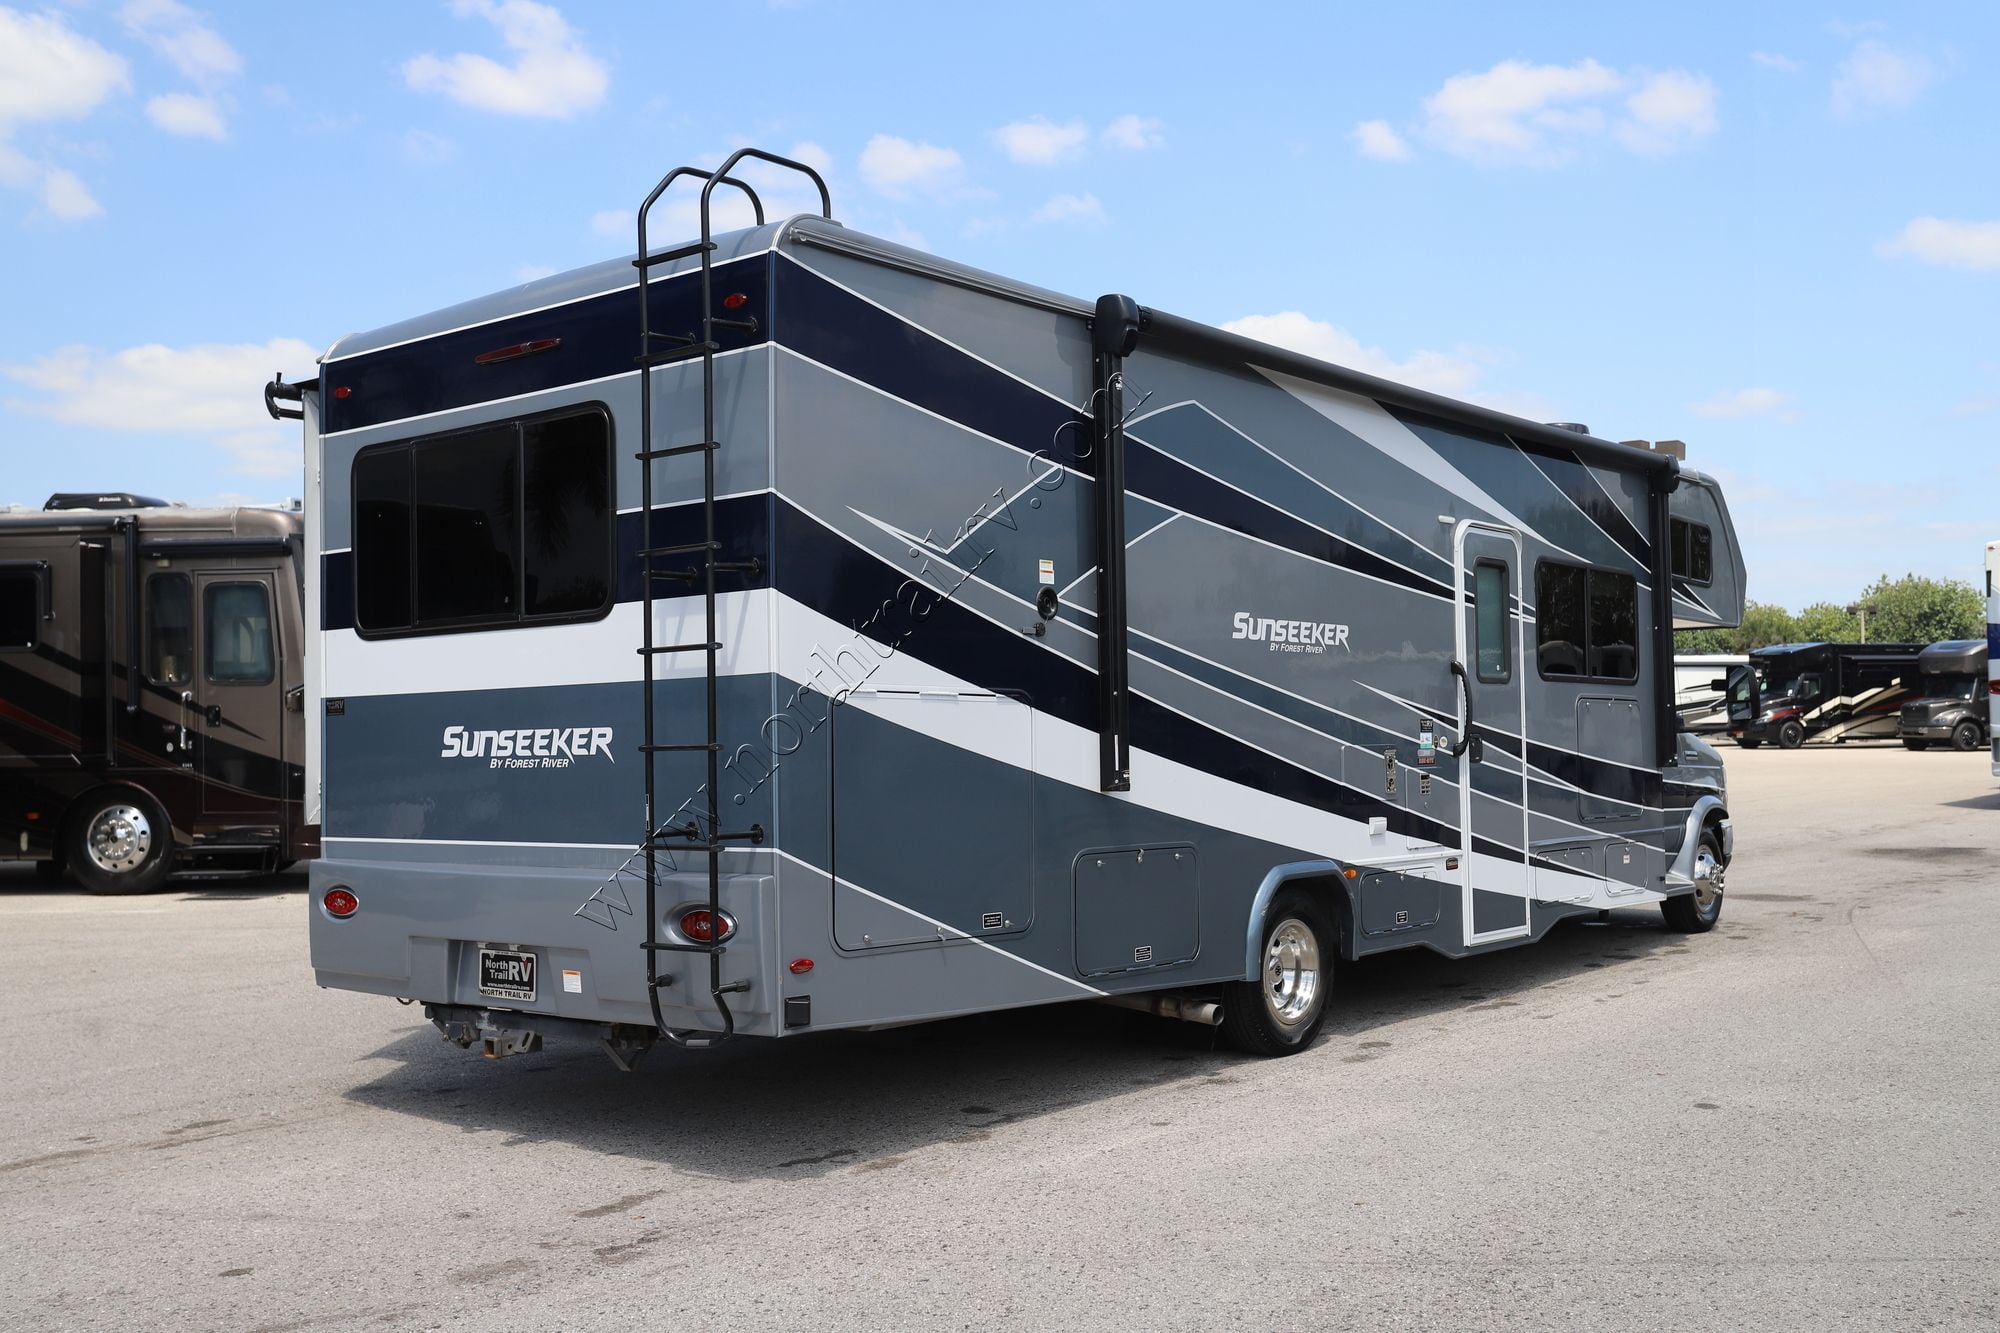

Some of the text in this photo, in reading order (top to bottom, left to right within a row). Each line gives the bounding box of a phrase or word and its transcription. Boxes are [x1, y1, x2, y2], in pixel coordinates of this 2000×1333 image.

[504, 757, 540, 769] FOREST
[541, 757, 570, 768] RIVER
[485, 958, 508, 970] North
[489, 969, 508, 980] Trail
[508, 960, 532, 982] RV
[481, 988, 532, 1000] NORTH TRAIL RV
